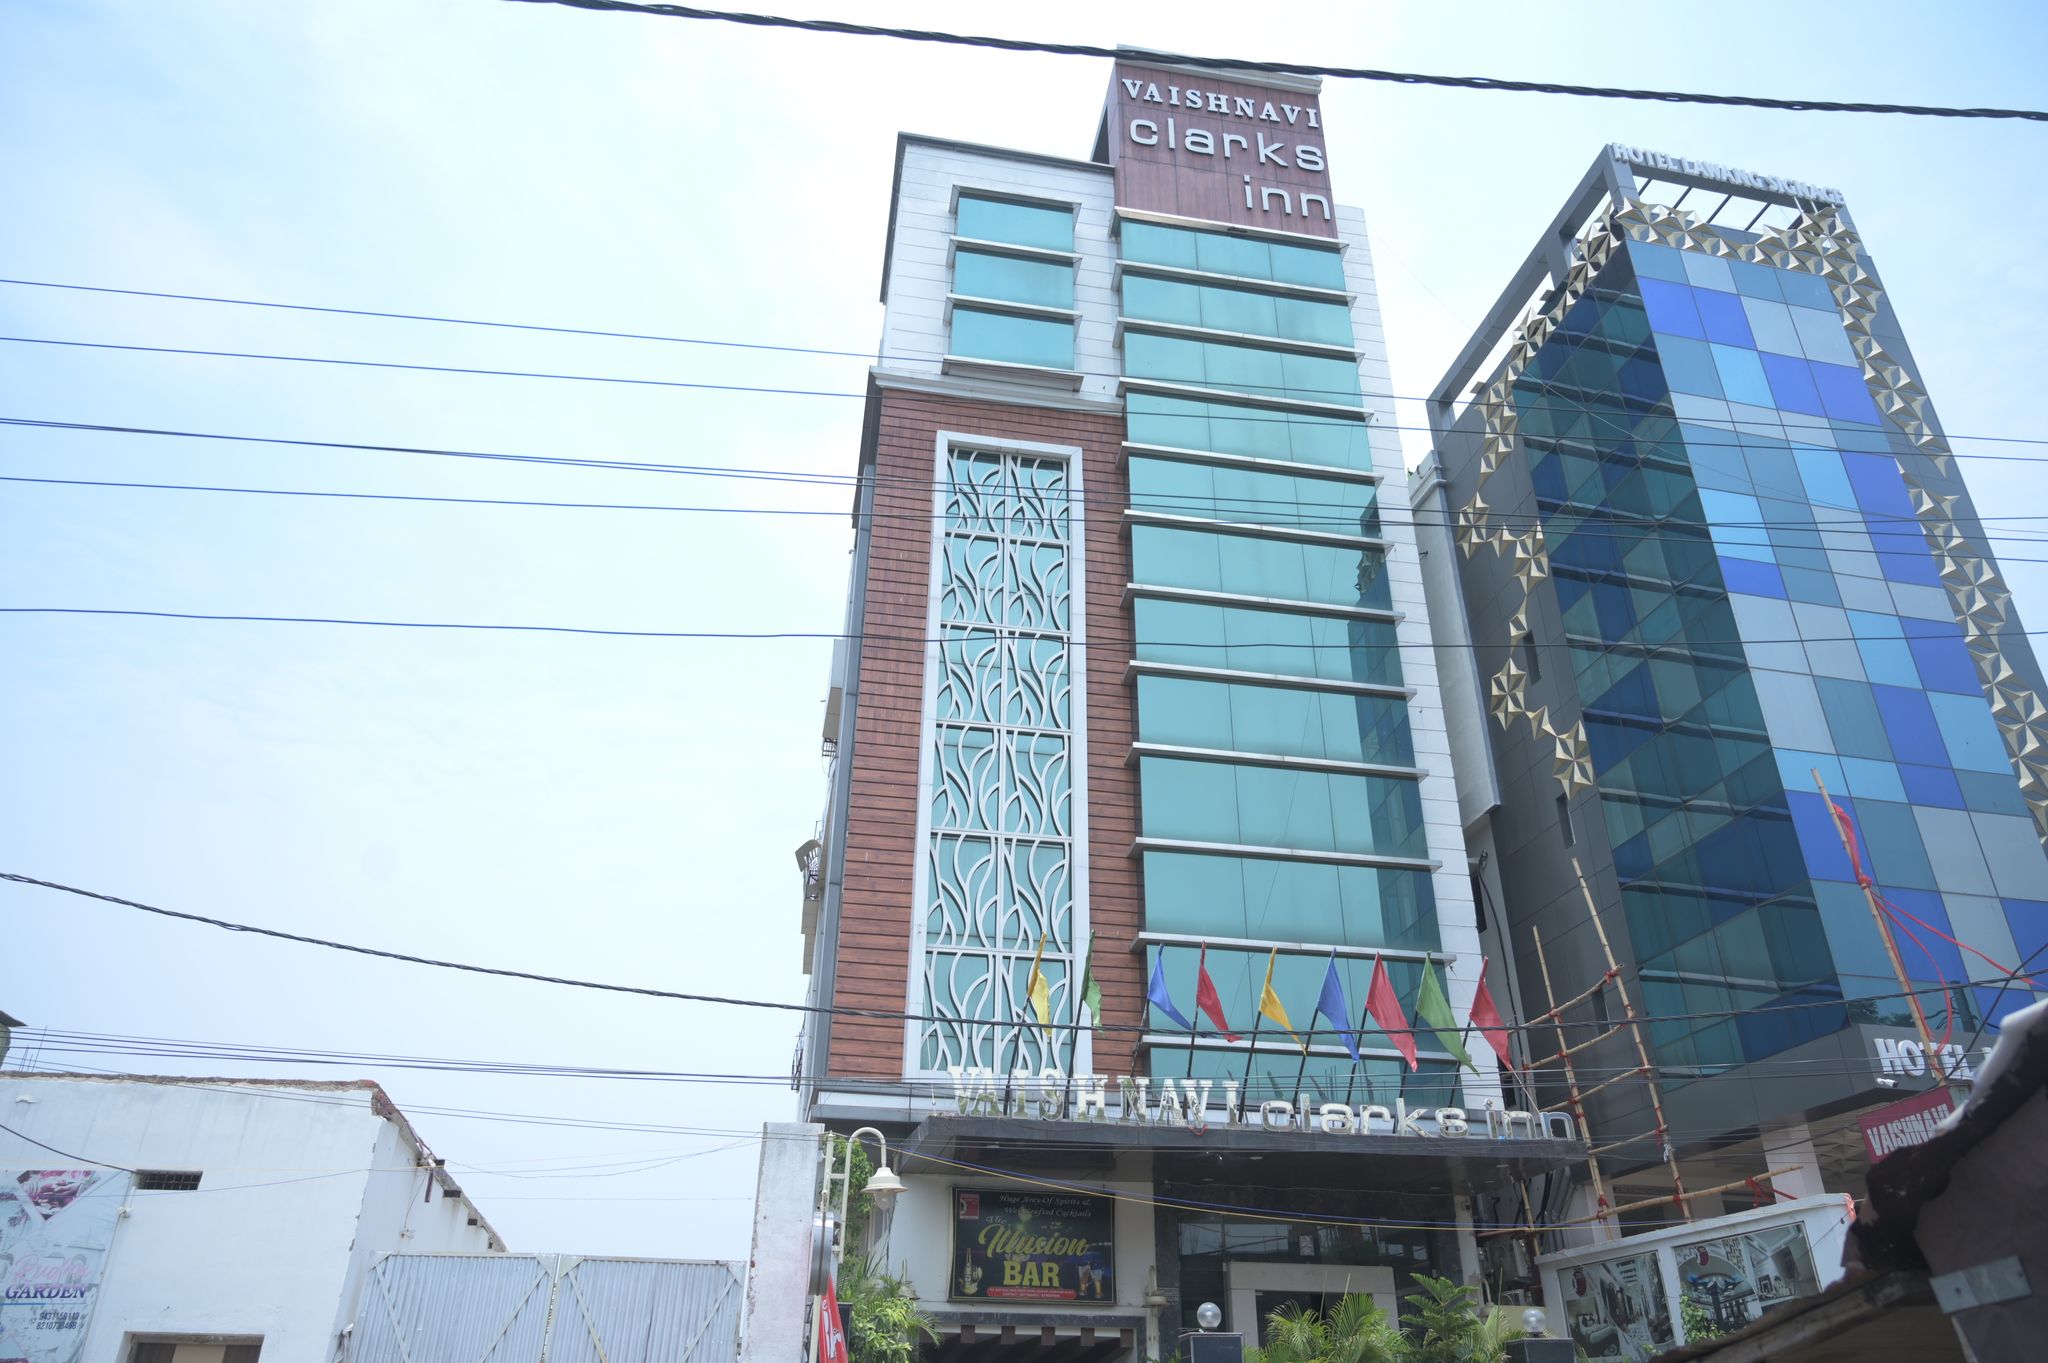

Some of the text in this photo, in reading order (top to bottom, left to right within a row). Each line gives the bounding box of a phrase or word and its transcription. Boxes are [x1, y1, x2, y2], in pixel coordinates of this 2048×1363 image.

[1121, 78, 1319, 128] VAISHNAVI
[1129, 117, 1325, 172] clarks
[1612, 142, 1678, 171] HOTEL
[1243, 174, 1330, 220] inn
[946, 1065, 1577, 1141] VAISHNAVI clarks inn
[986, 1216, 1007, 1224] The
[1056, 1208, 1092, 1217] Cocktails
[978, 1224, 1089, 1258] Illusion
[1003, 1260, 1060, 1287] BAR
[5, 1284, 87, 1299] GARDEN
